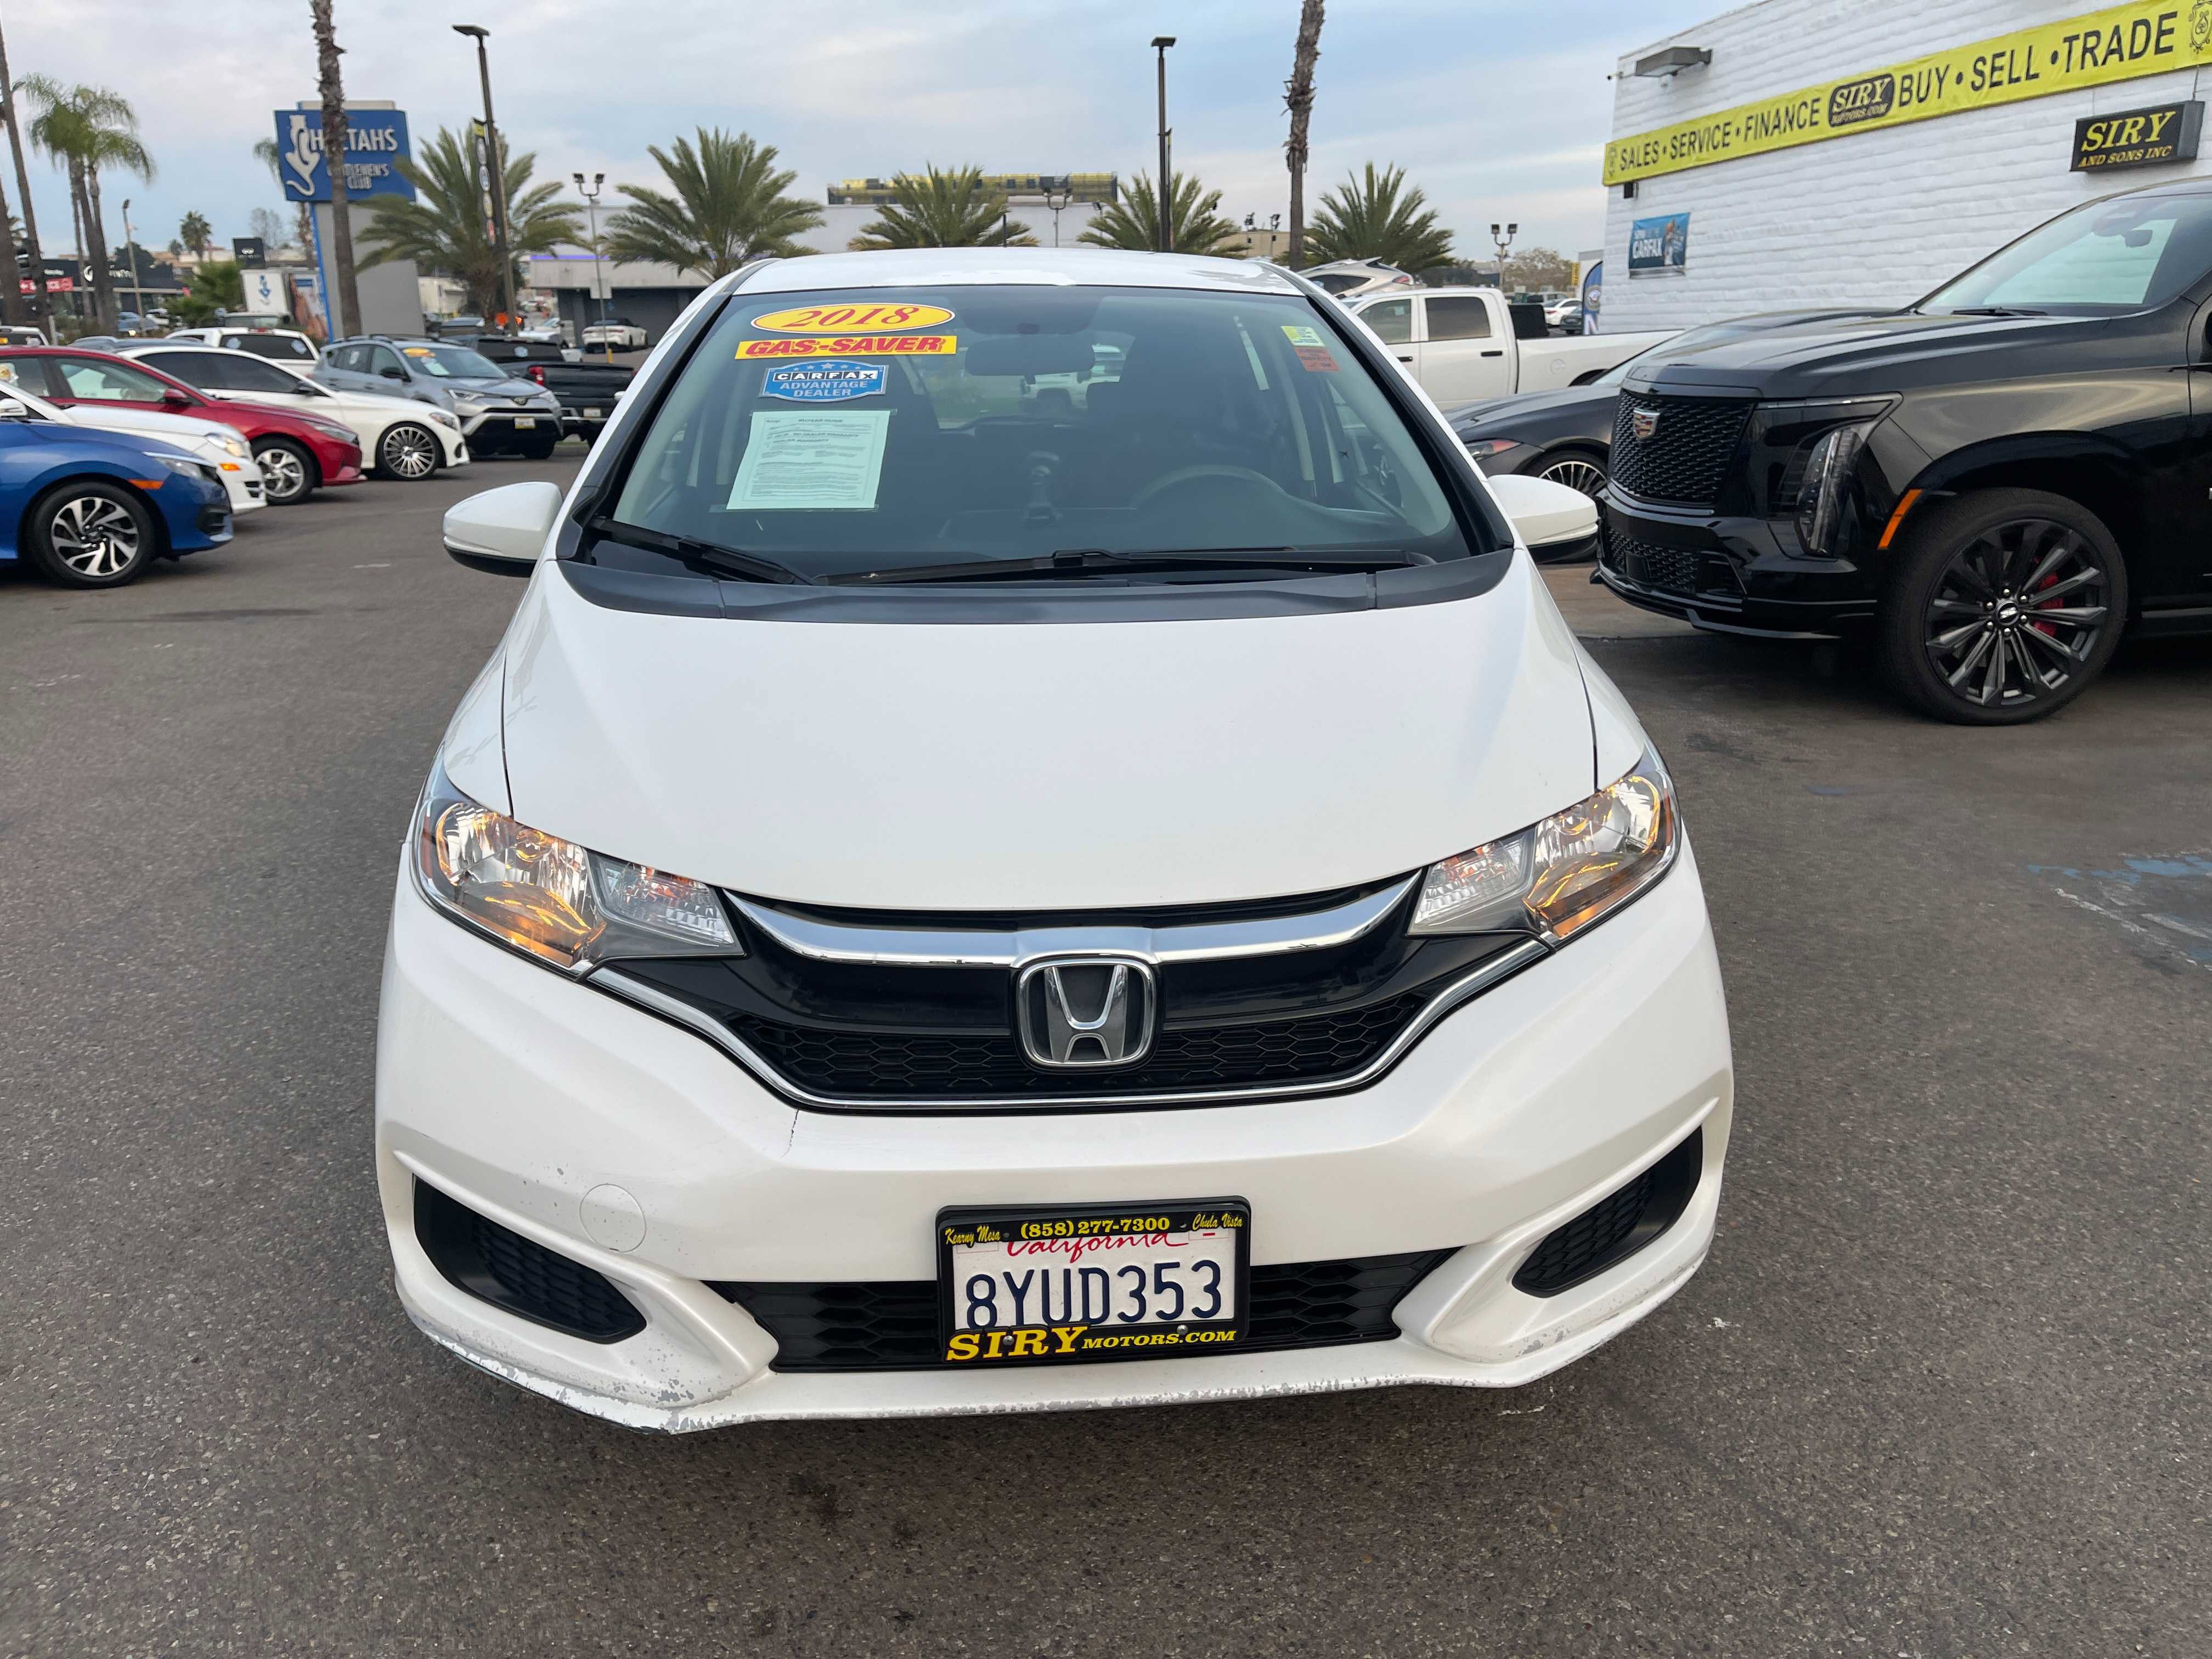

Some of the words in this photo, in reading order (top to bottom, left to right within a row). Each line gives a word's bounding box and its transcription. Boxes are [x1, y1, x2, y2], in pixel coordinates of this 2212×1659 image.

[1899, 64, 1950, 106] BUY
[1970, 45, 2040, 91] SELL
[2063, 10, 2178, 73] TRADE
[1833, 77, 1892, 112] SIRY
[1620, 140, 1660, 171] SALES
[1669, 121, 1732, 160] SERVICE
[1744, 98, 1821, 142] FINANCE
[2081, 111, 2177, 152] SIRY
[2078, 154, 2106, 168] AND
[2107, 148, 2144, 163] SONS
[2145, 145, 2173, 159] INC
[781, 307, 920, 328] 2018
[746, 337, 946, 356] GAS-SAVER
[776, 371, 876, 381] CARFAX
[780, 381, 868, 390] ADVANTAGE
[793, 388, 852, 397] DEALER
[1020, 1220, 1074, 1239] (858)
[1077, 1217, 1170, 1234] 277-7300
[1193, 1213, 1218, 1231] Chula
[1221, 1212, 1243, 1228] Vista
[945, 1228, 974, 1246] Kearny
[977, 1224, 1001, 1242] Mesa
[966, 1260, 1222, 1328] 8YUD353
[946, 1326, 1088, 1361] SIRY
[1081, 1330, 1237, 1349] MOTORS.COM
